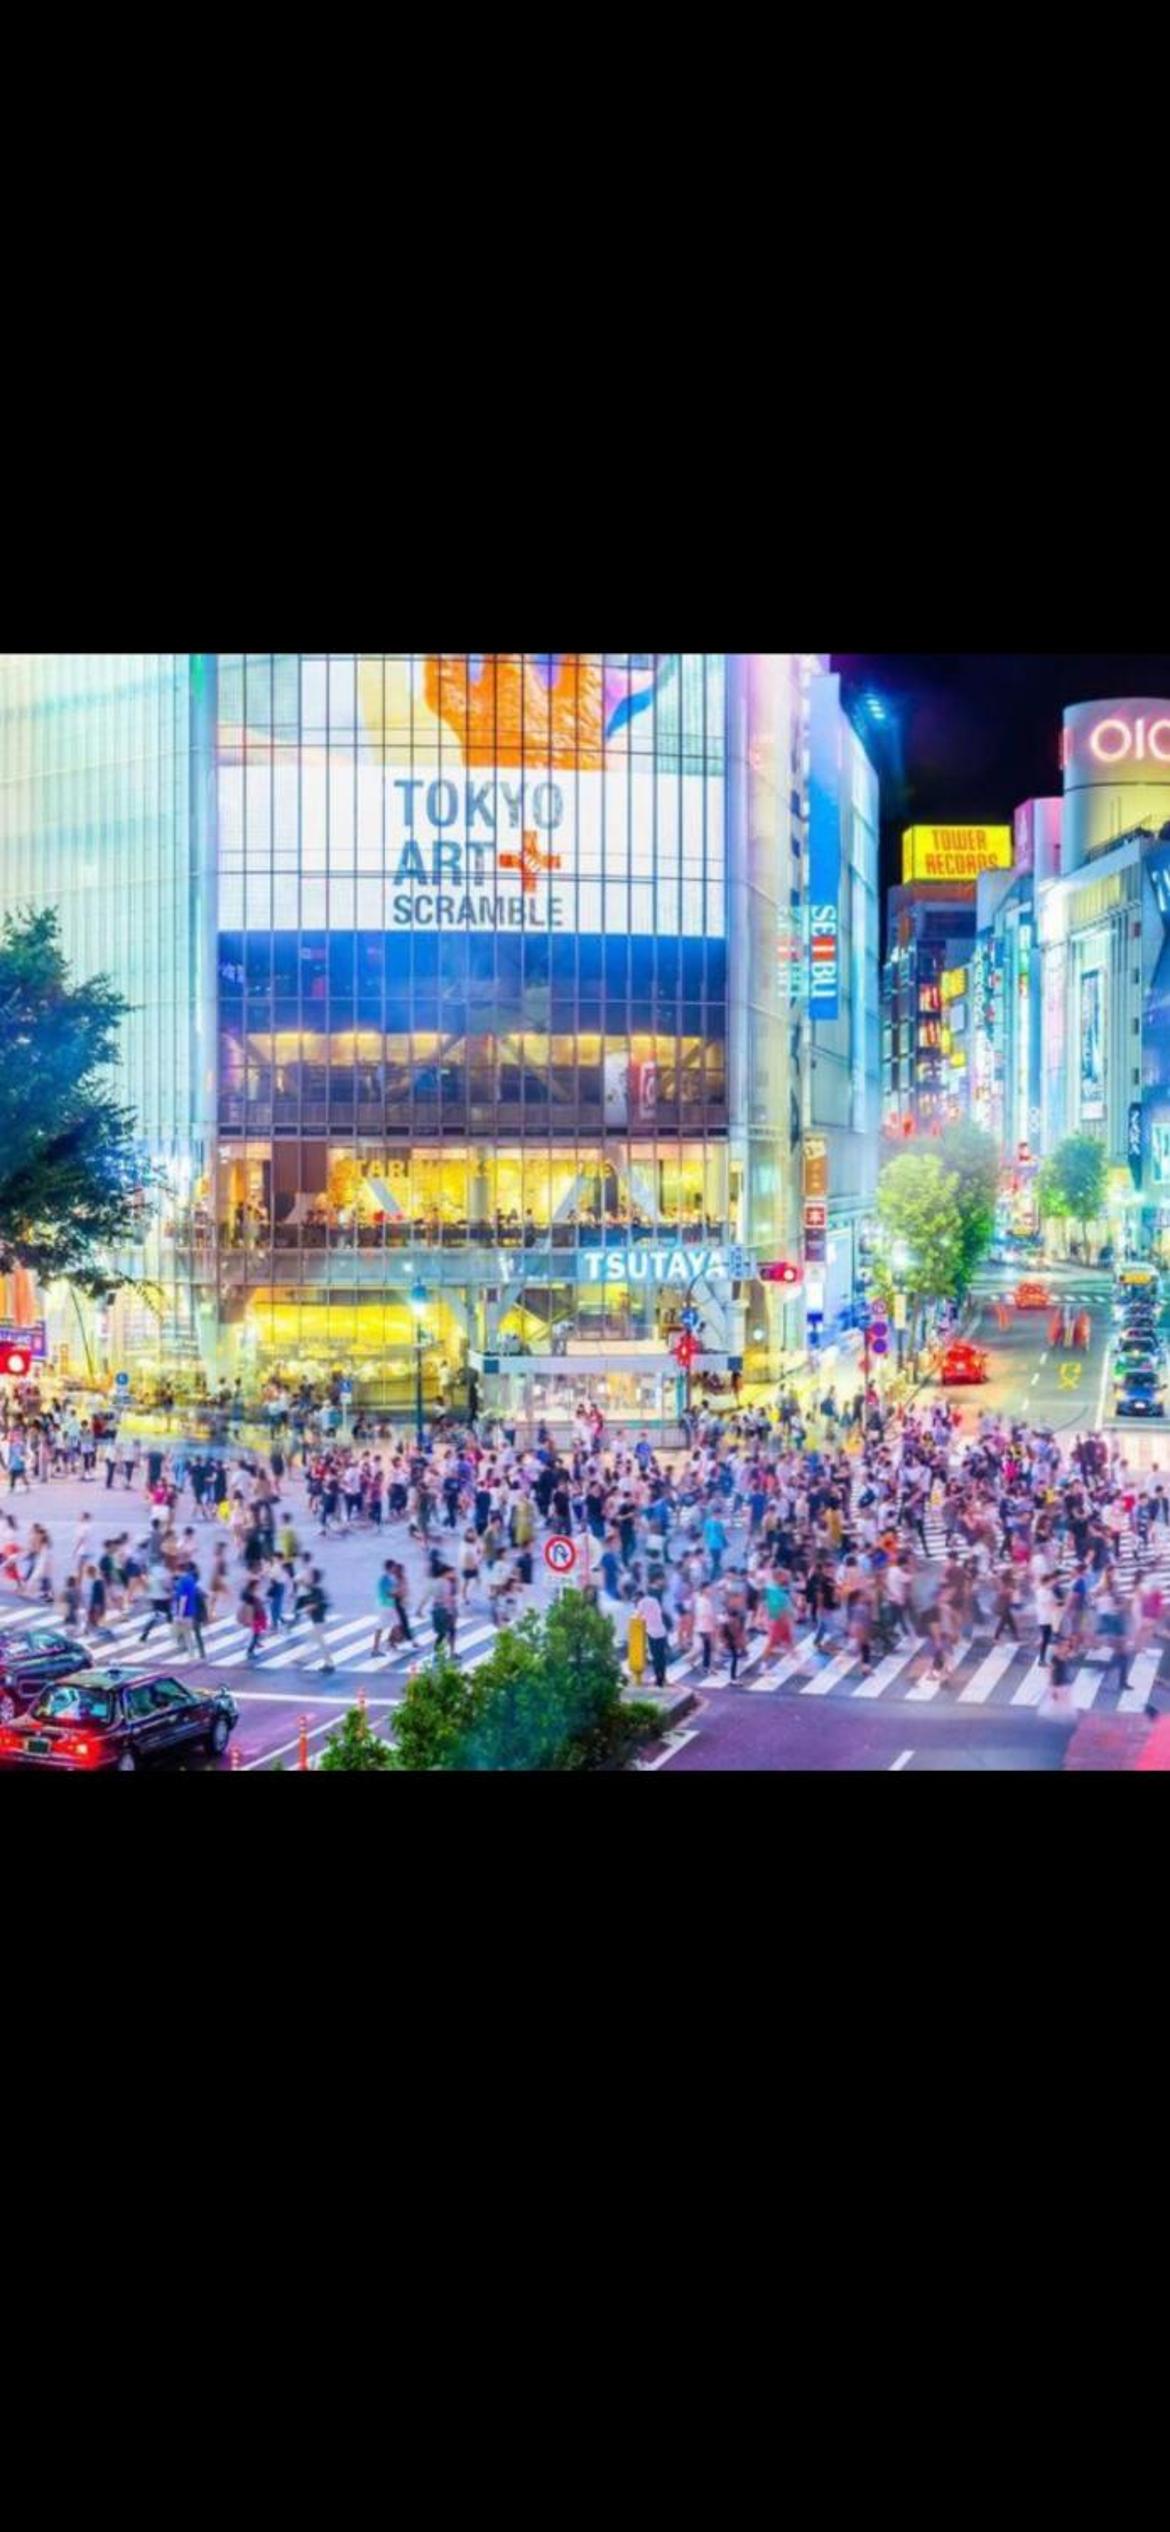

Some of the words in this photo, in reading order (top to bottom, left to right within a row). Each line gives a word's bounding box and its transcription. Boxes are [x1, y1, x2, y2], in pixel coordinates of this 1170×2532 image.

[393, 779, 563, 829] TOKYO
[932, 829, 987, 851] TOWER
[393, 894, 563, 926] SCRAMBLE
[811, 905, 837, 997] SEIBU
[584, 1251, 726, 1280] TSUTAYA
